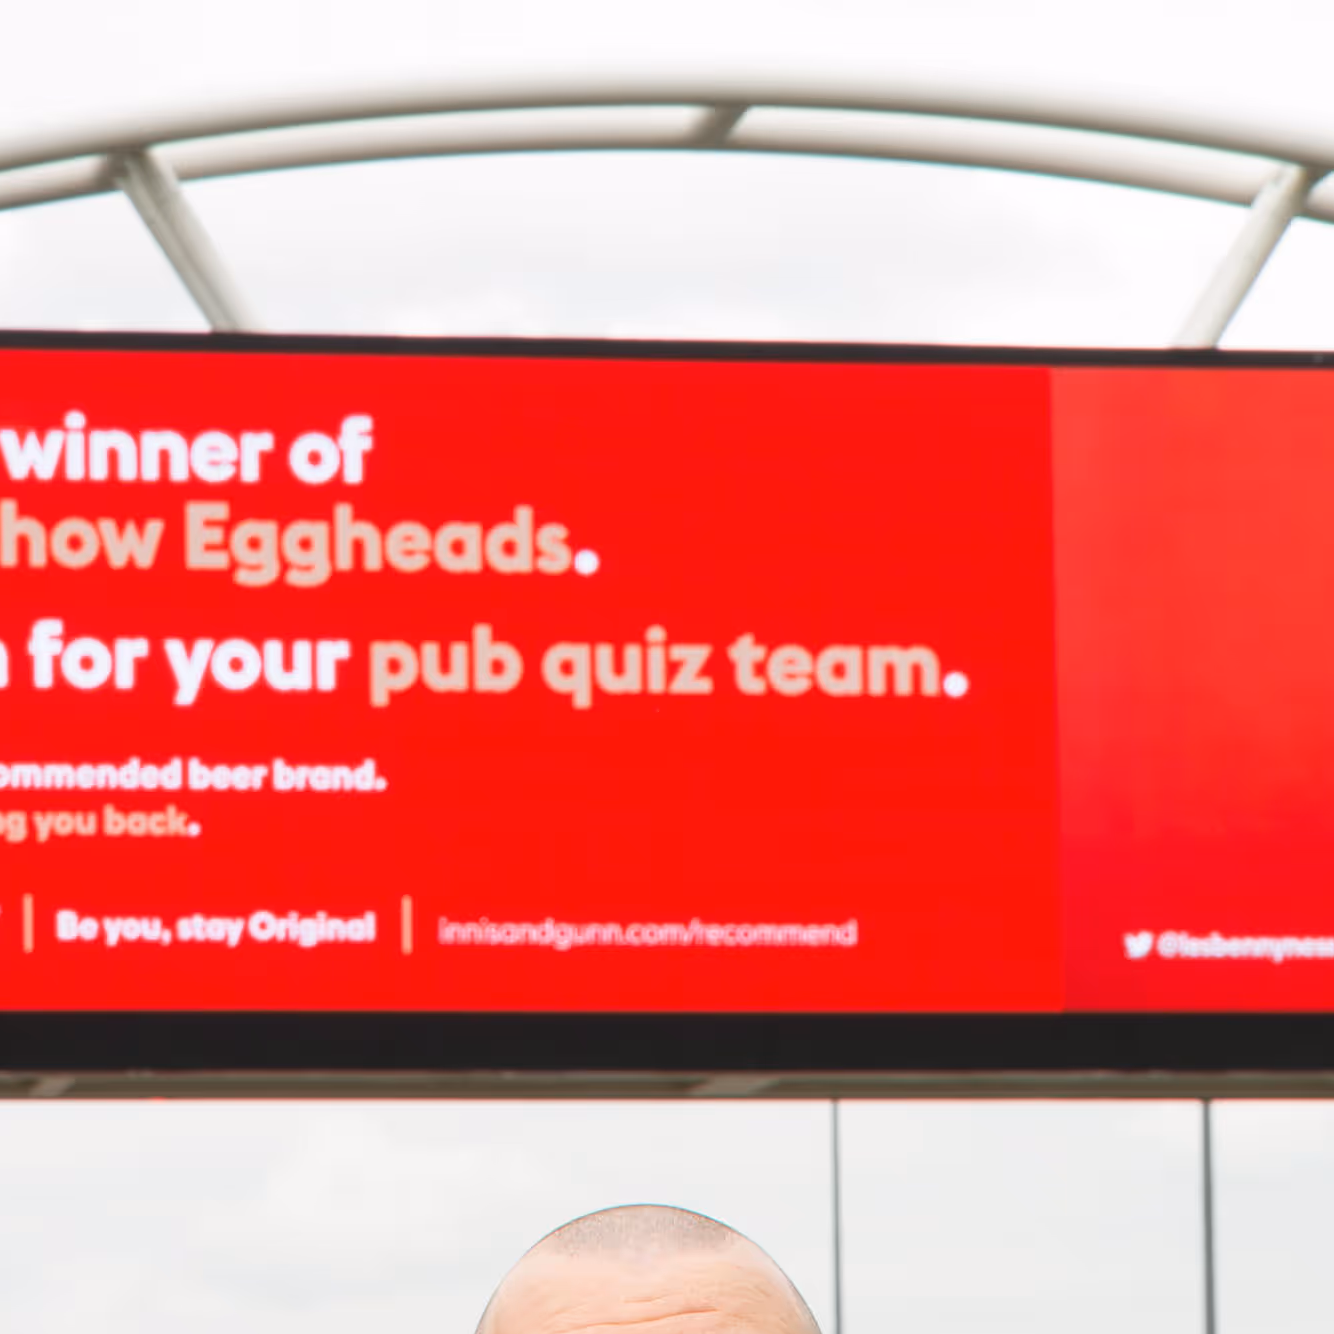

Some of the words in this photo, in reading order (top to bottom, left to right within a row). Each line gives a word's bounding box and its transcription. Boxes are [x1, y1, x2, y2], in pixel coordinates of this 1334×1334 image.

[289, 415, 373, 484] of
[185, 502, 599, 587] Eggheads.
[27, 618, 149, 689] for
[164, 638, 350, 706] your
[370, 624, 522, 706] pub
[543, 626, 712, 708] quiz
[728, 634, 968, 698] team.
[188, 757, 267, 790] beer
[273, 758, 387, 791] brand.
[34, 811, 96, 842] you
[104, 804, 200, 837] back.
[56, 910, 98, 941] Be
[103, 917, 172, 947] you,
[177, 914, 244, 947] stay
[248, 911, 376, 947] Original
[438, 917, 858, 951] innisandgunn.com/recommend
